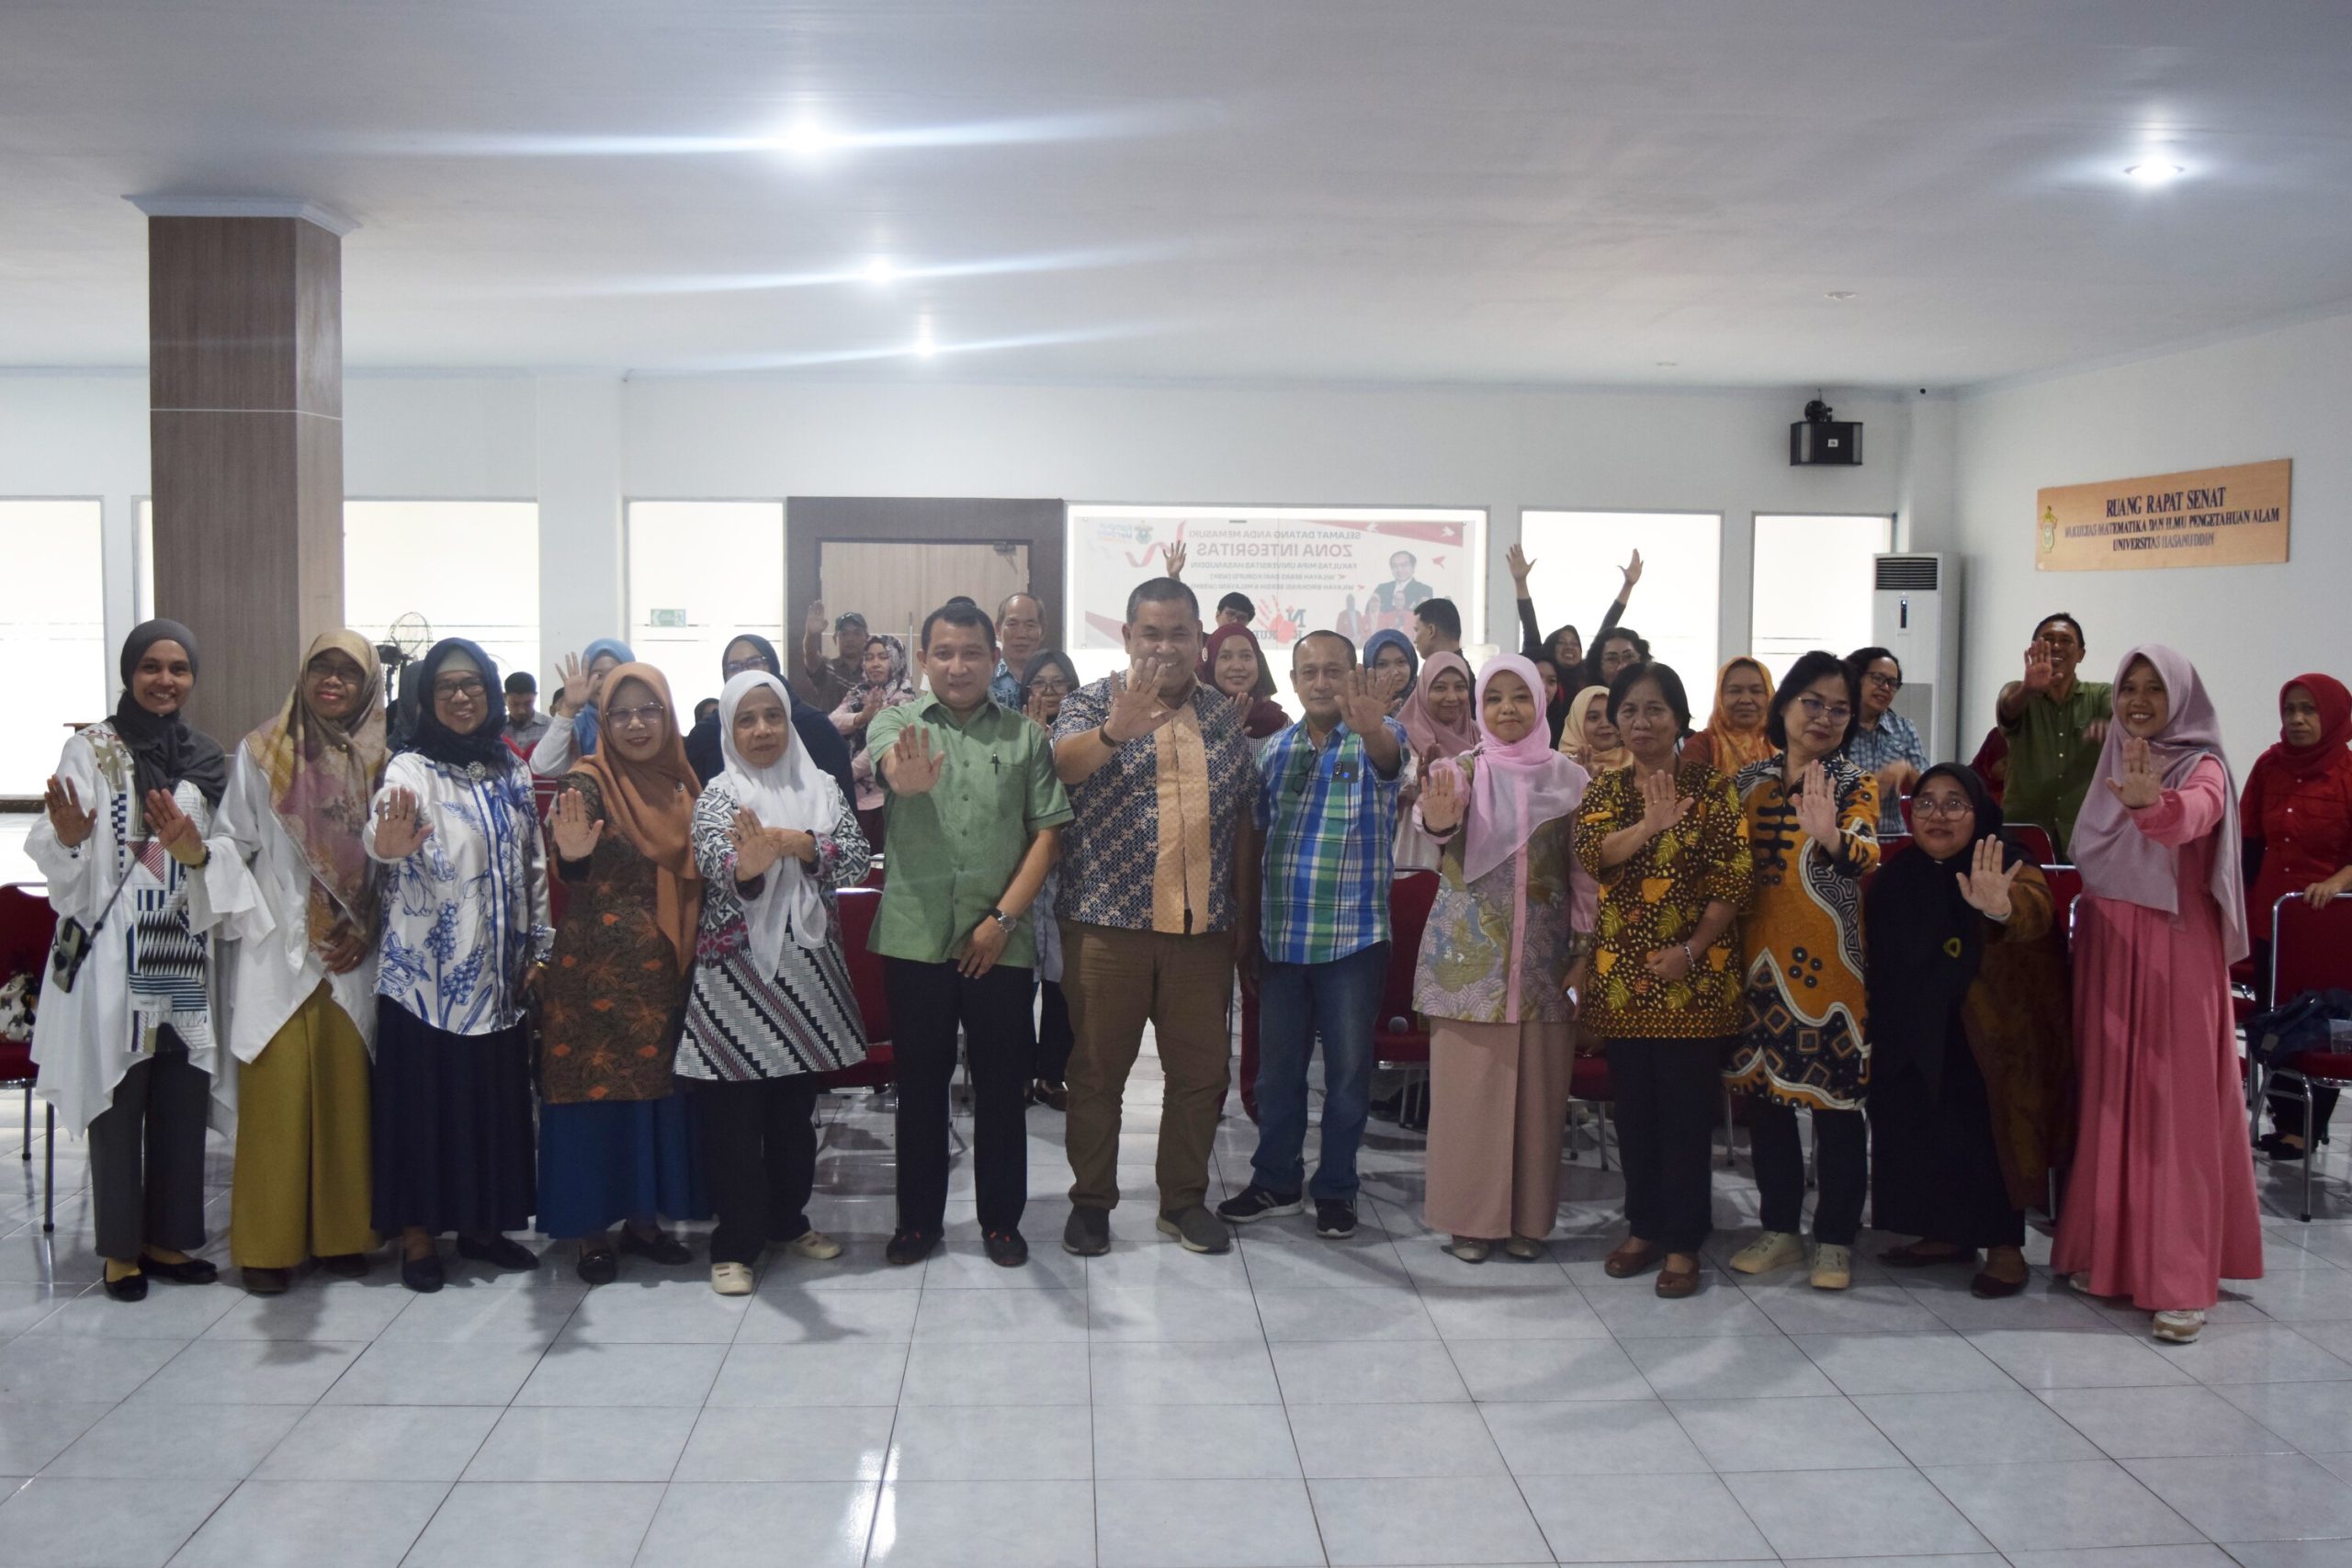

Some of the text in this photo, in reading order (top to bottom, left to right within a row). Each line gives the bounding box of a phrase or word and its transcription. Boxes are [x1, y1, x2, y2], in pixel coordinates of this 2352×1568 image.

[2106, 487, 2226, 517] RUANG RAPAT SENAT
[2098, 519, 2147, 536] MATEMATIKA
[2149, 517, 2165, 531] DAN
[2165, 515, 2187, 530] ILMU
[2188, 510, 2250, 527] PENGETAHUAN
[2252, 507, 2279, 523] ALAM
[2113, 533, 2215, 551] UNIVERSITAS HASANUDDIN
